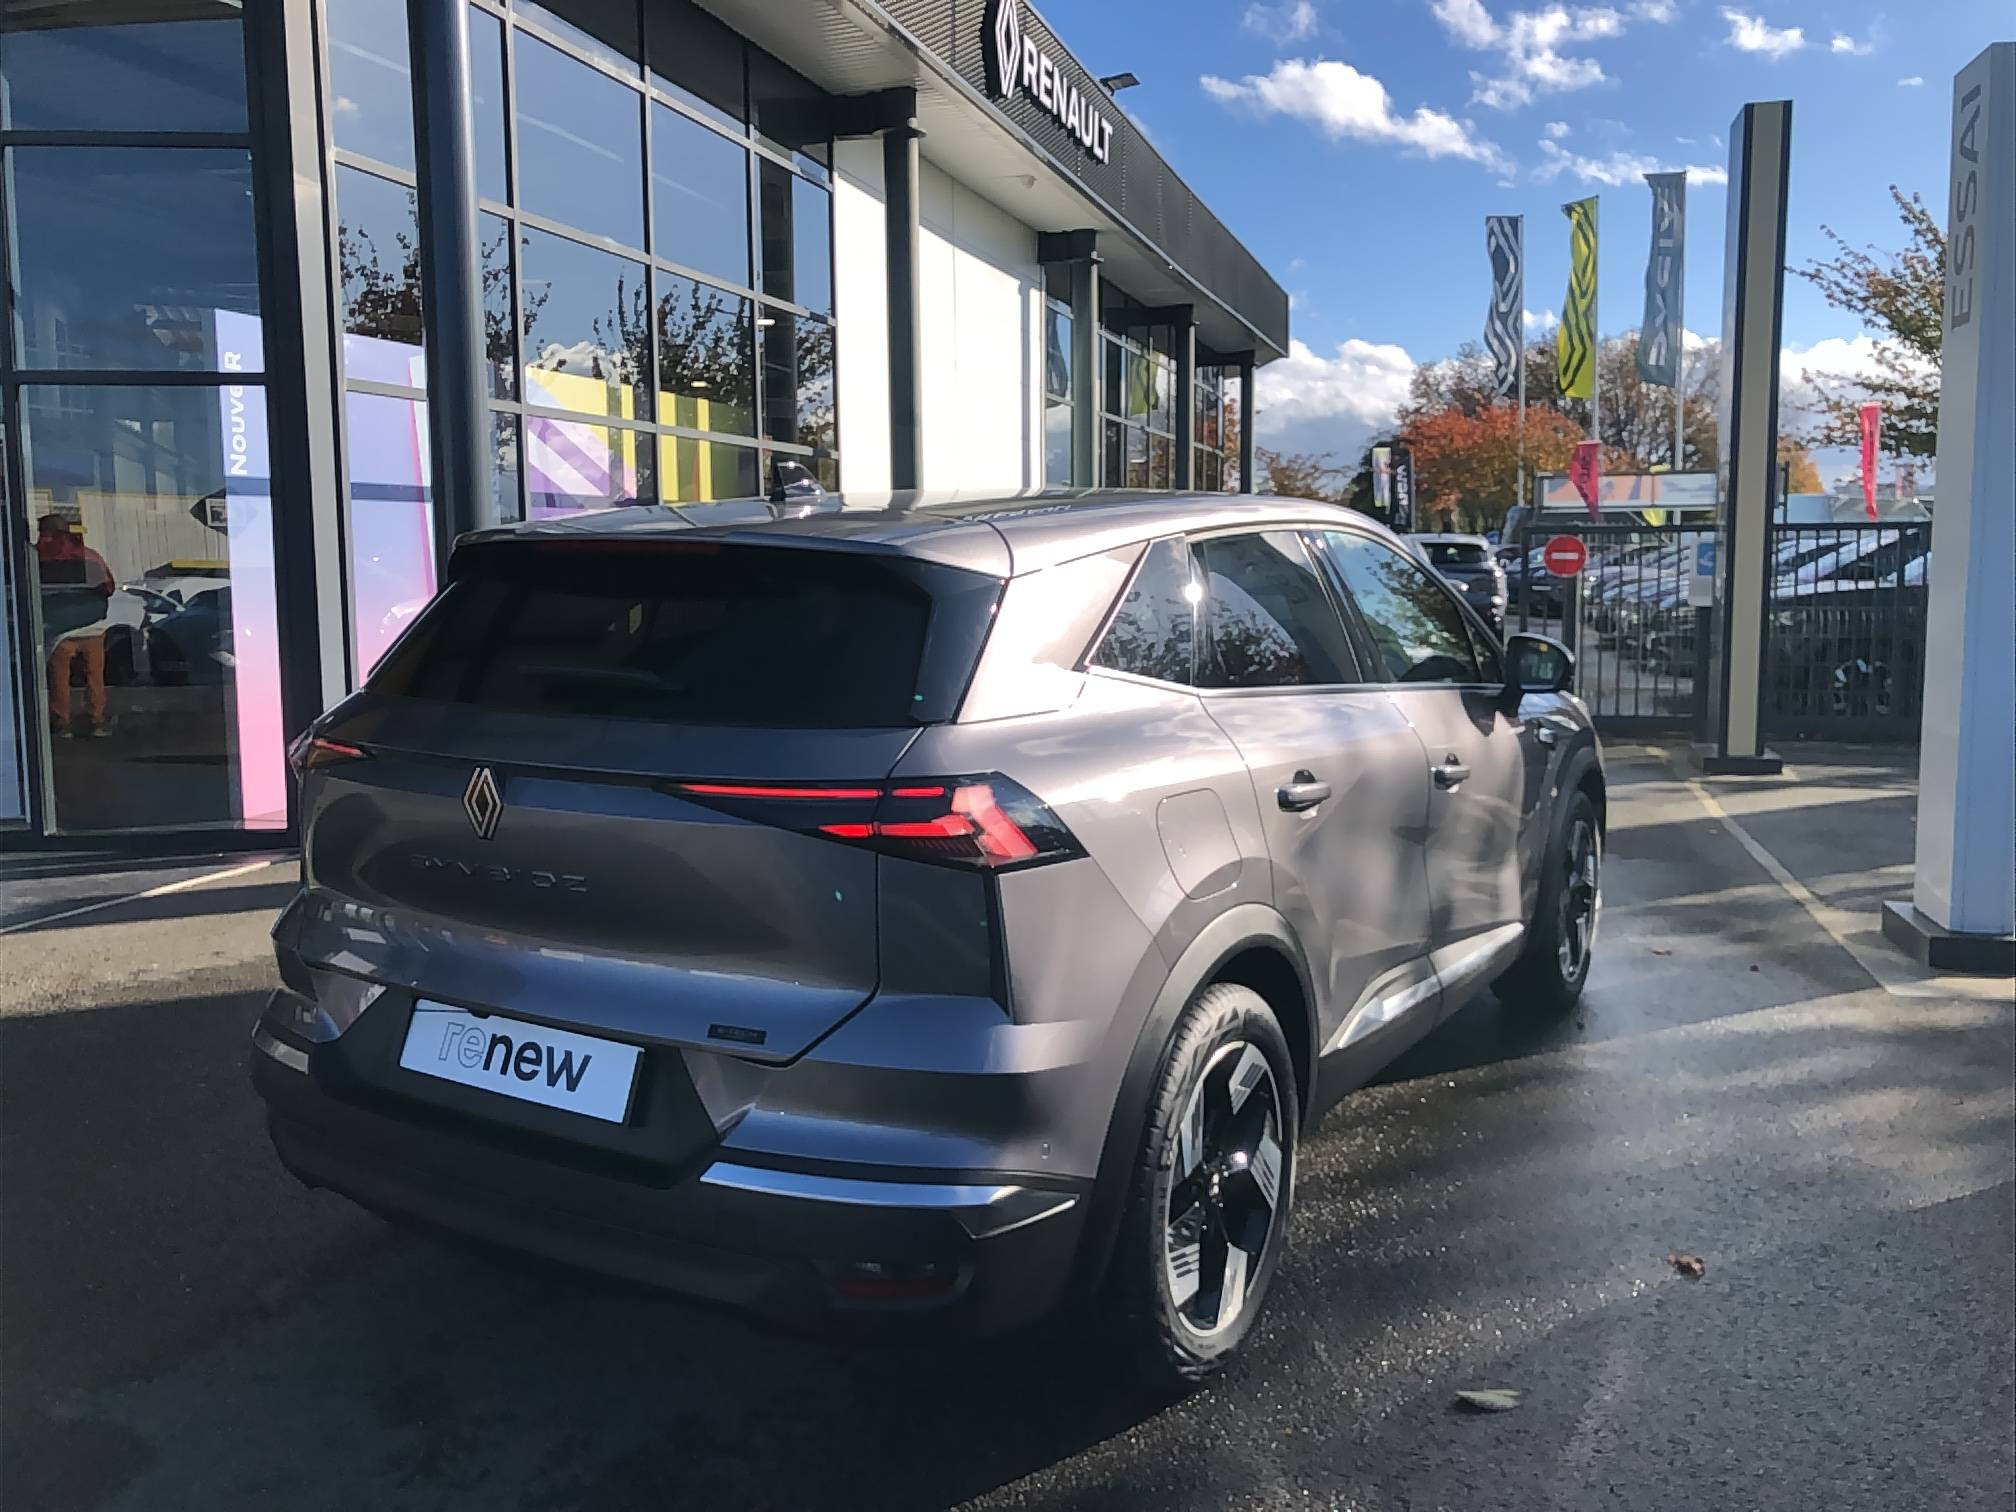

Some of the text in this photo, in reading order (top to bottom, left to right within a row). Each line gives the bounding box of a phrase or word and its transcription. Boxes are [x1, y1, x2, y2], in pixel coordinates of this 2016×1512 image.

[1022, 34, 1113, 165] RENAULT
[1952, 83, 1982, 329] ESSAI
[438, 1021, 593, 1092] renew
